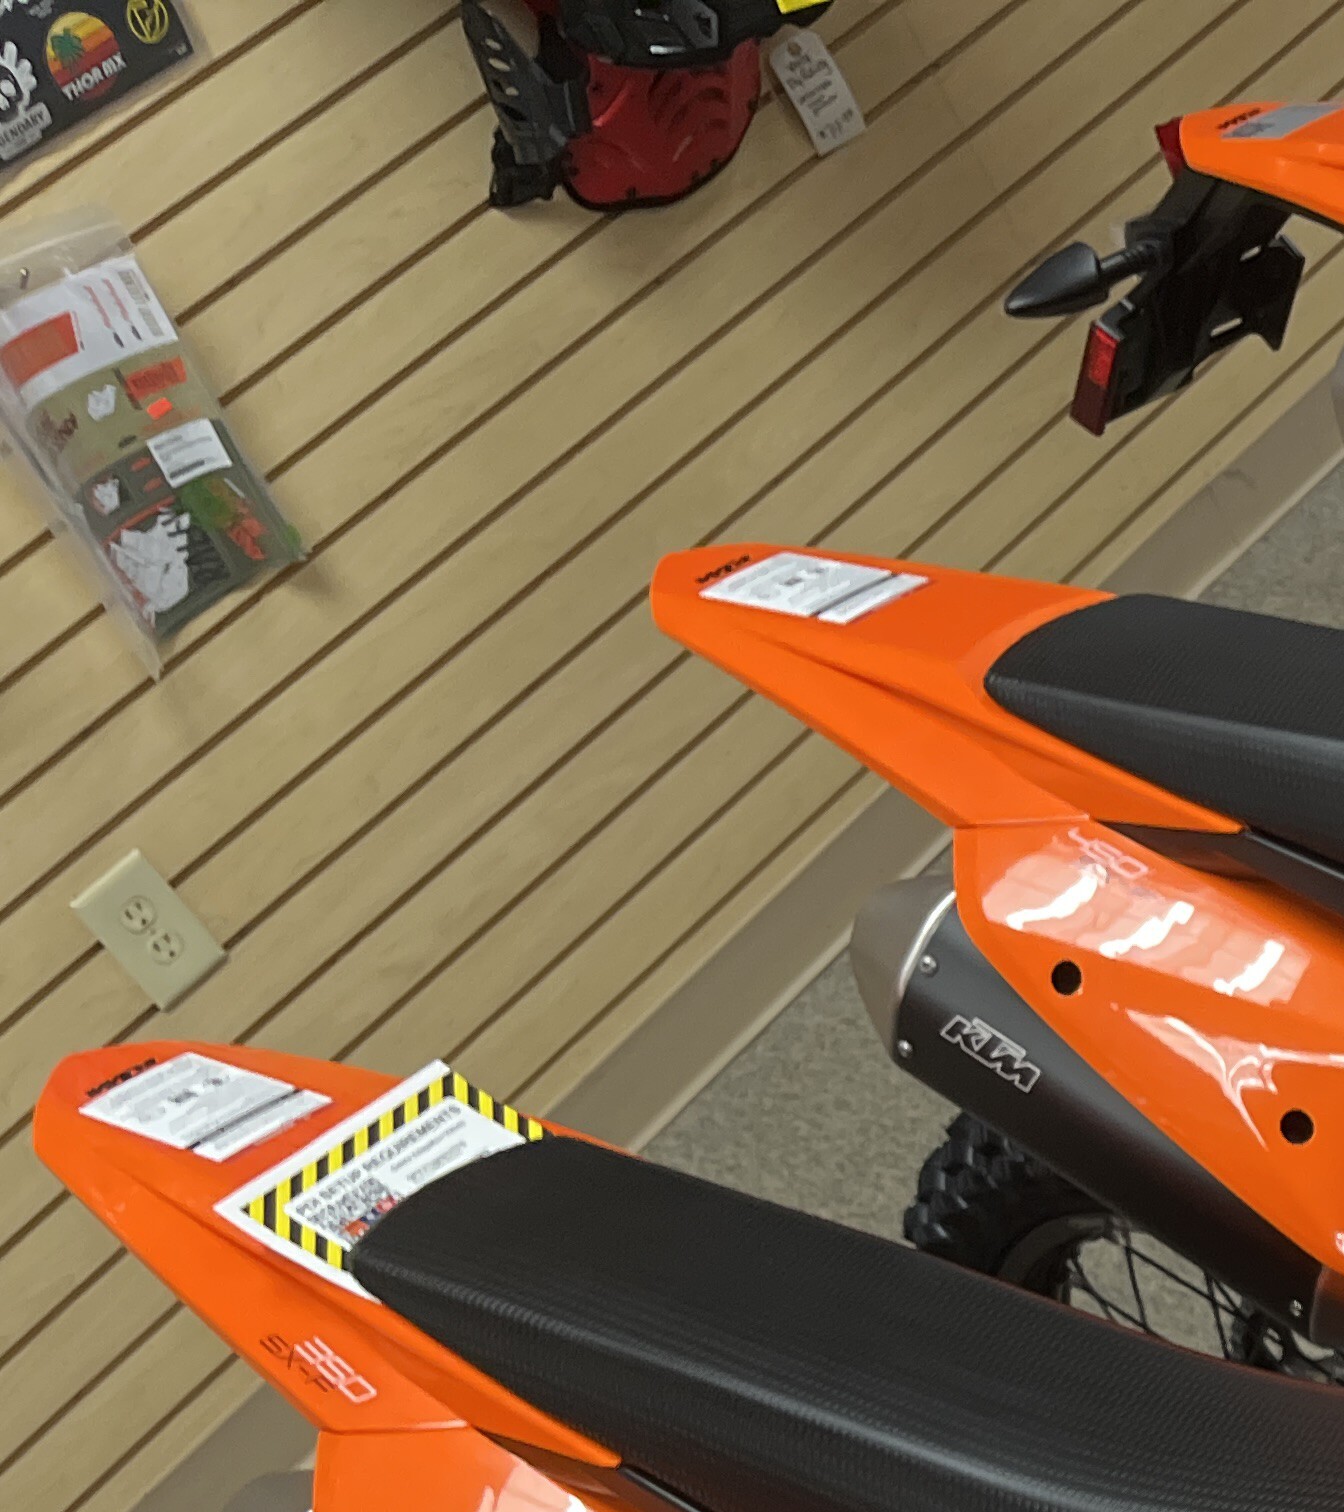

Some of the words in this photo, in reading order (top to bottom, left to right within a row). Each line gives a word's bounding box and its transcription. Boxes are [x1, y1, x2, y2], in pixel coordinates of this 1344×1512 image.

[61, 66, 104, 101] THOR
[102, 51, 127, 79] MX
[940, 1014, 1042, 1093] KTM
[293, 1335, 378, 1404] 350
